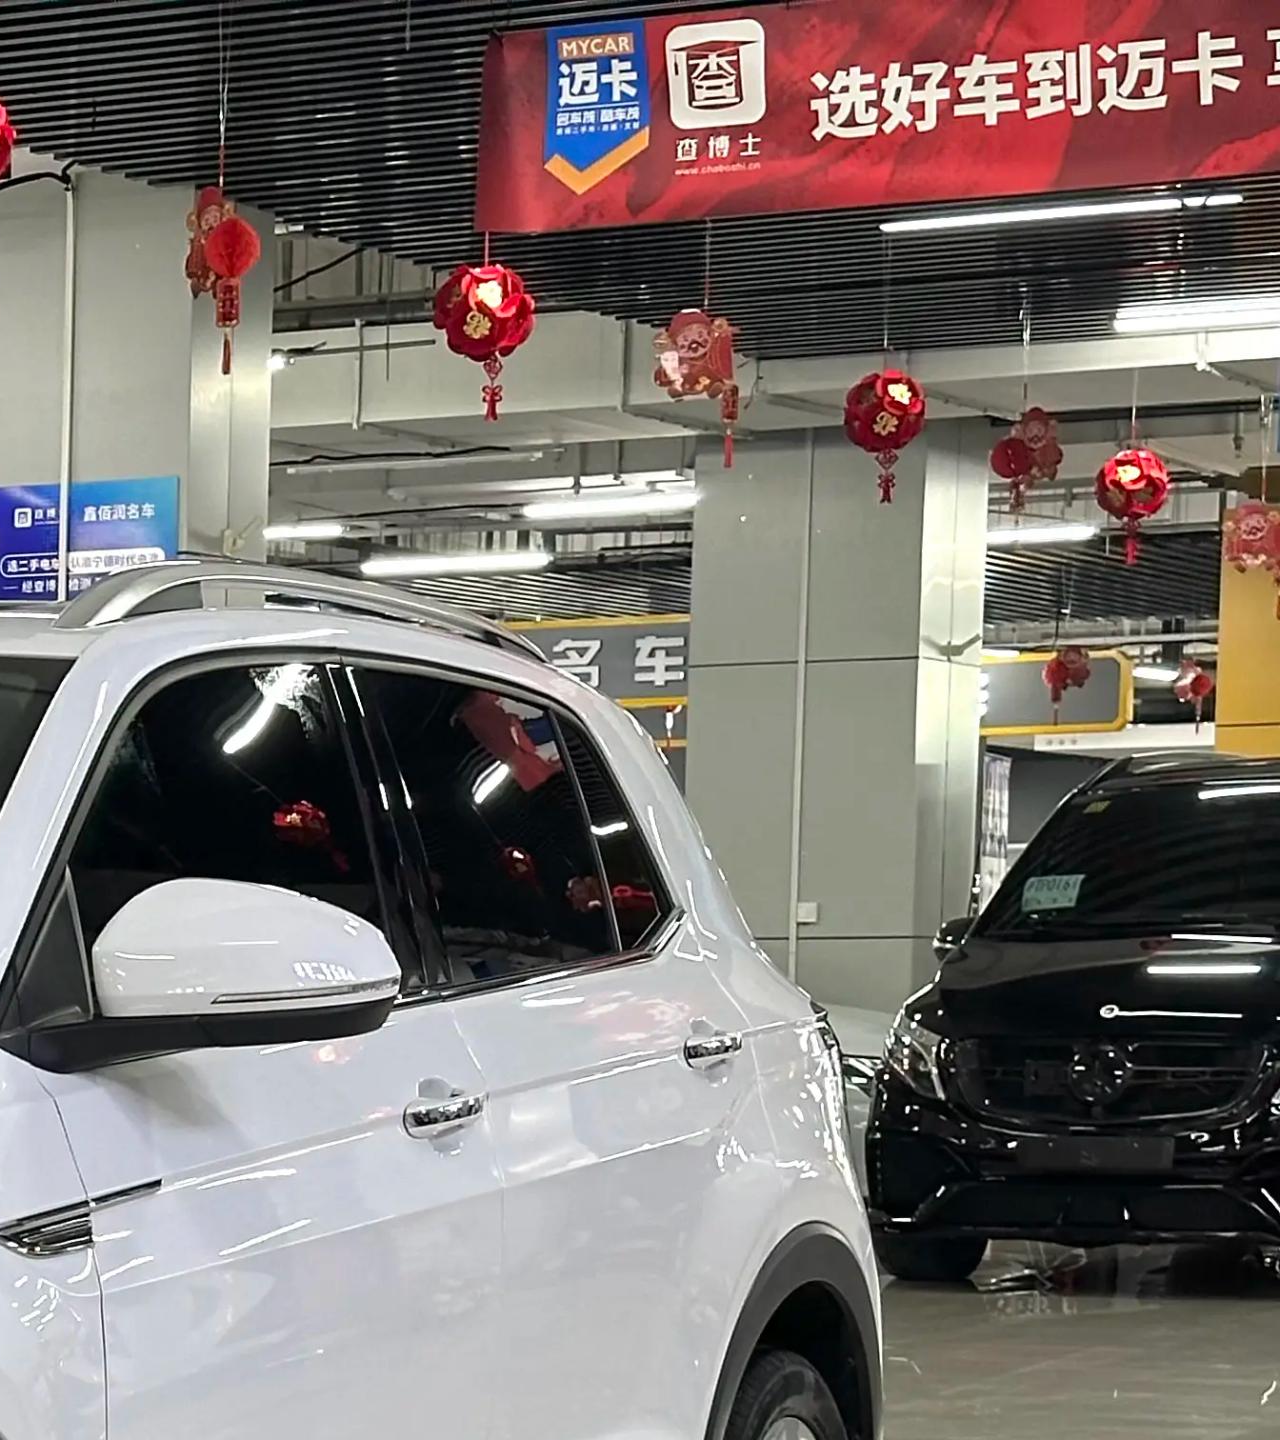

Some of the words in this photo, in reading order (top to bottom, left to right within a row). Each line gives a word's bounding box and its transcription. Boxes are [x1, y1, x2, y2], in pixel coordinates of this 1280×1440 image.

[561, 36, 632, 58] MYCAR
[558, 58, 639, 108] 迈卡
[809, 30, 1244, 142] 选好车到迈卡
[674, 132, 762, 162] 查博士
[83, 503, 156, 522] 鑫佰润名车
[551, 635, 686, 687] 名车
